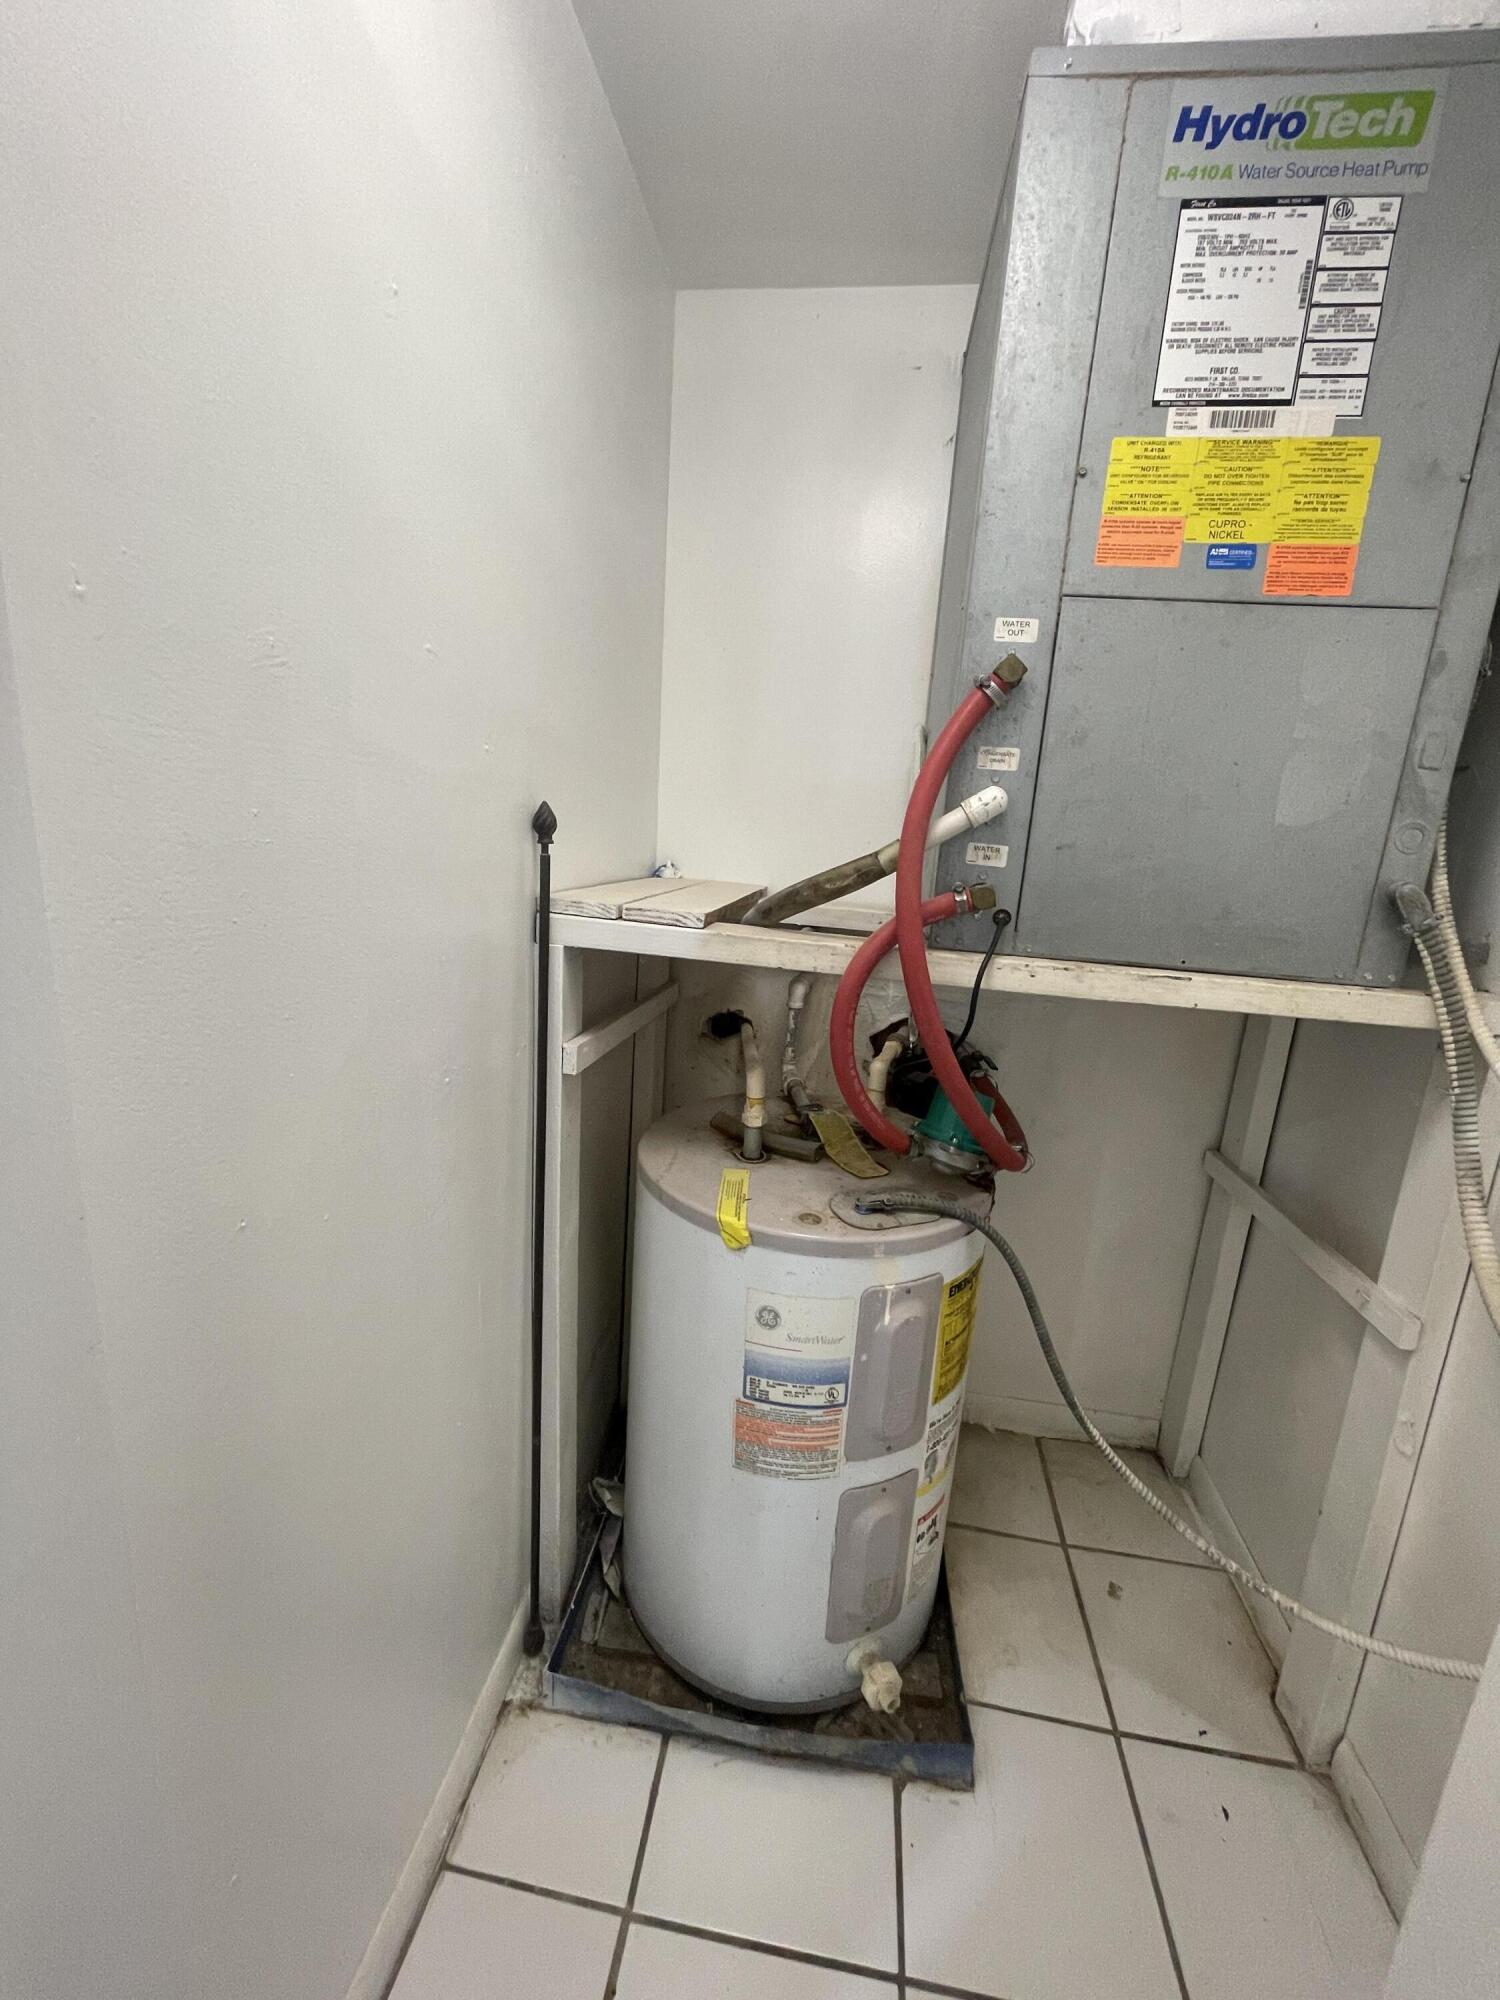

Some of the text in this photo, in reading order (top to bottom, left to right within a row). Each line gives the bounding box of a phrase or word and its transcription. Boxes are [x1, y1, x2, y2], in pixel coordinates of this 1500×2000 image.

[1172, 96, 1417, 151] HydroTech
[1165, 160, 1428, 182] R-410A Water Source Heat Pump
[1209, 366, 1228, 374] FIRST
[1208, 520, 1247, 529] CUPRO
[1208, 530, 1245, 539] NICKEL
[1002, 620, 1031, 628] WATER
[973, 845, 1001, 854] WATER
